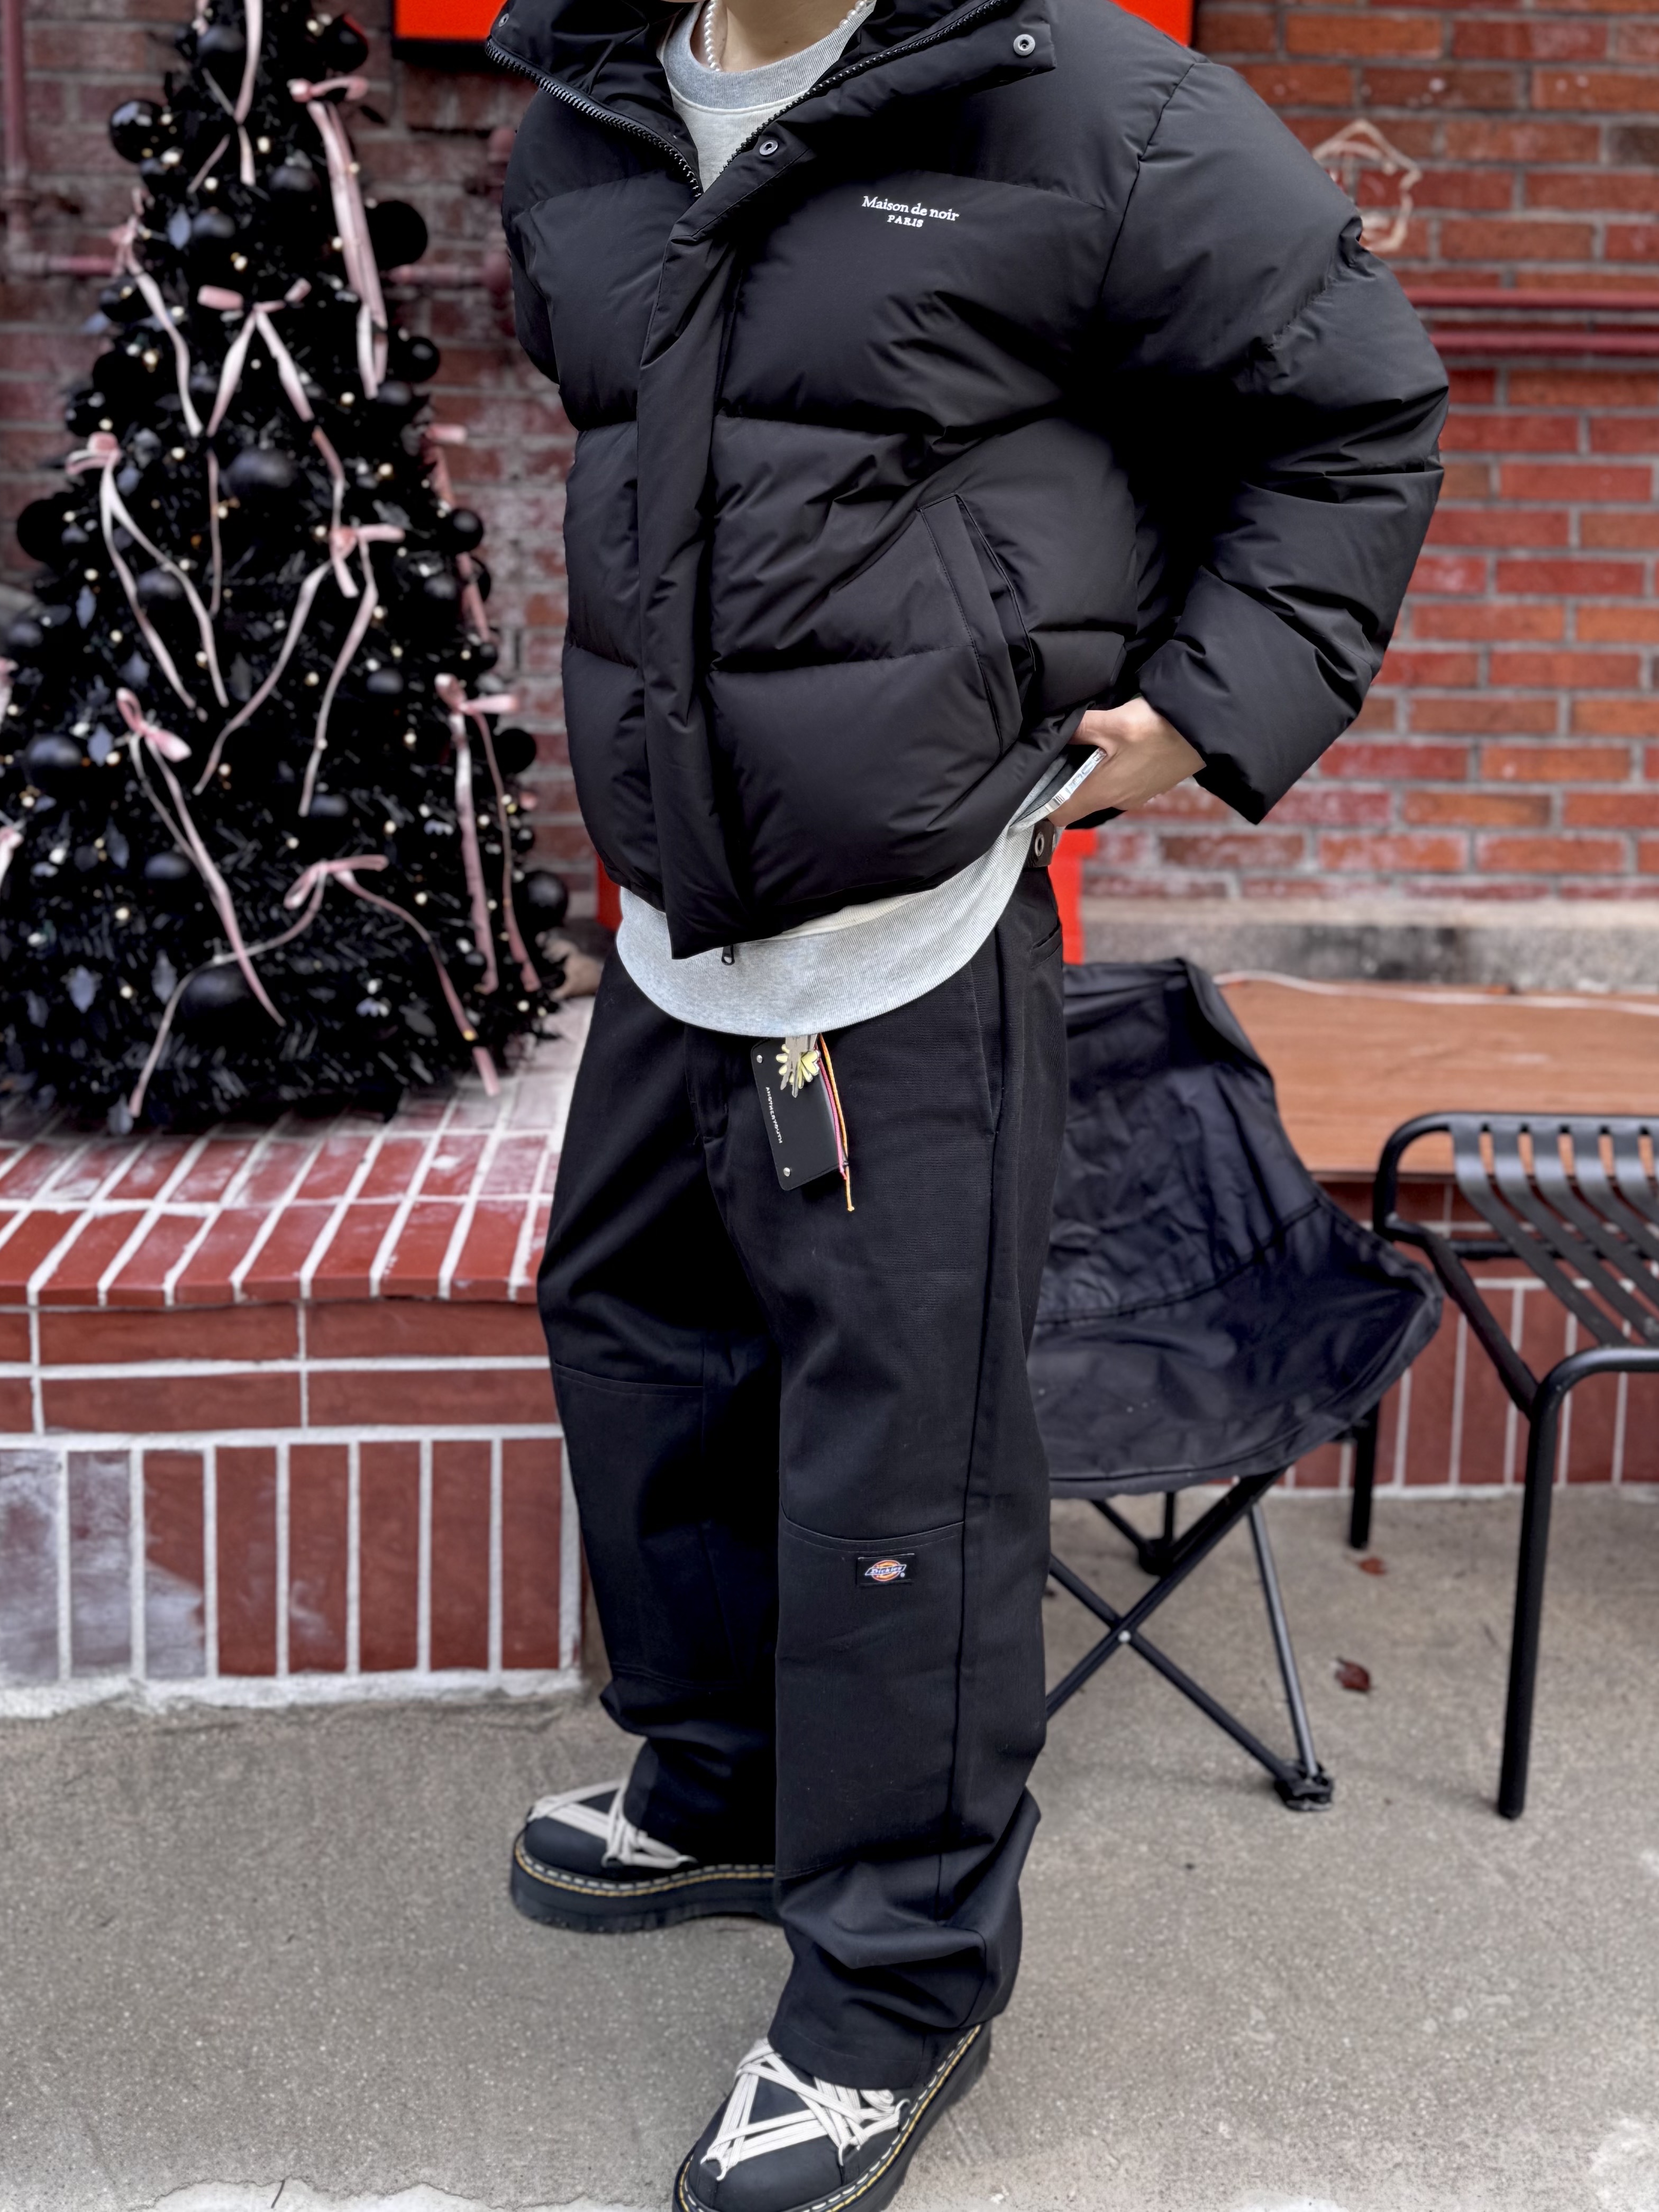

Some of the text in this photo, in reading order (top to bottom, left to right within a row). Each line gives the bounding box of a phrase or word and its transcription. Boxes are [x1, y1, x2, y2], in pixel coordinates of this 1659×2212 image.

[861, 195, 960, 222] Maison de noir
[887, 214, 924, 228] PARIS
